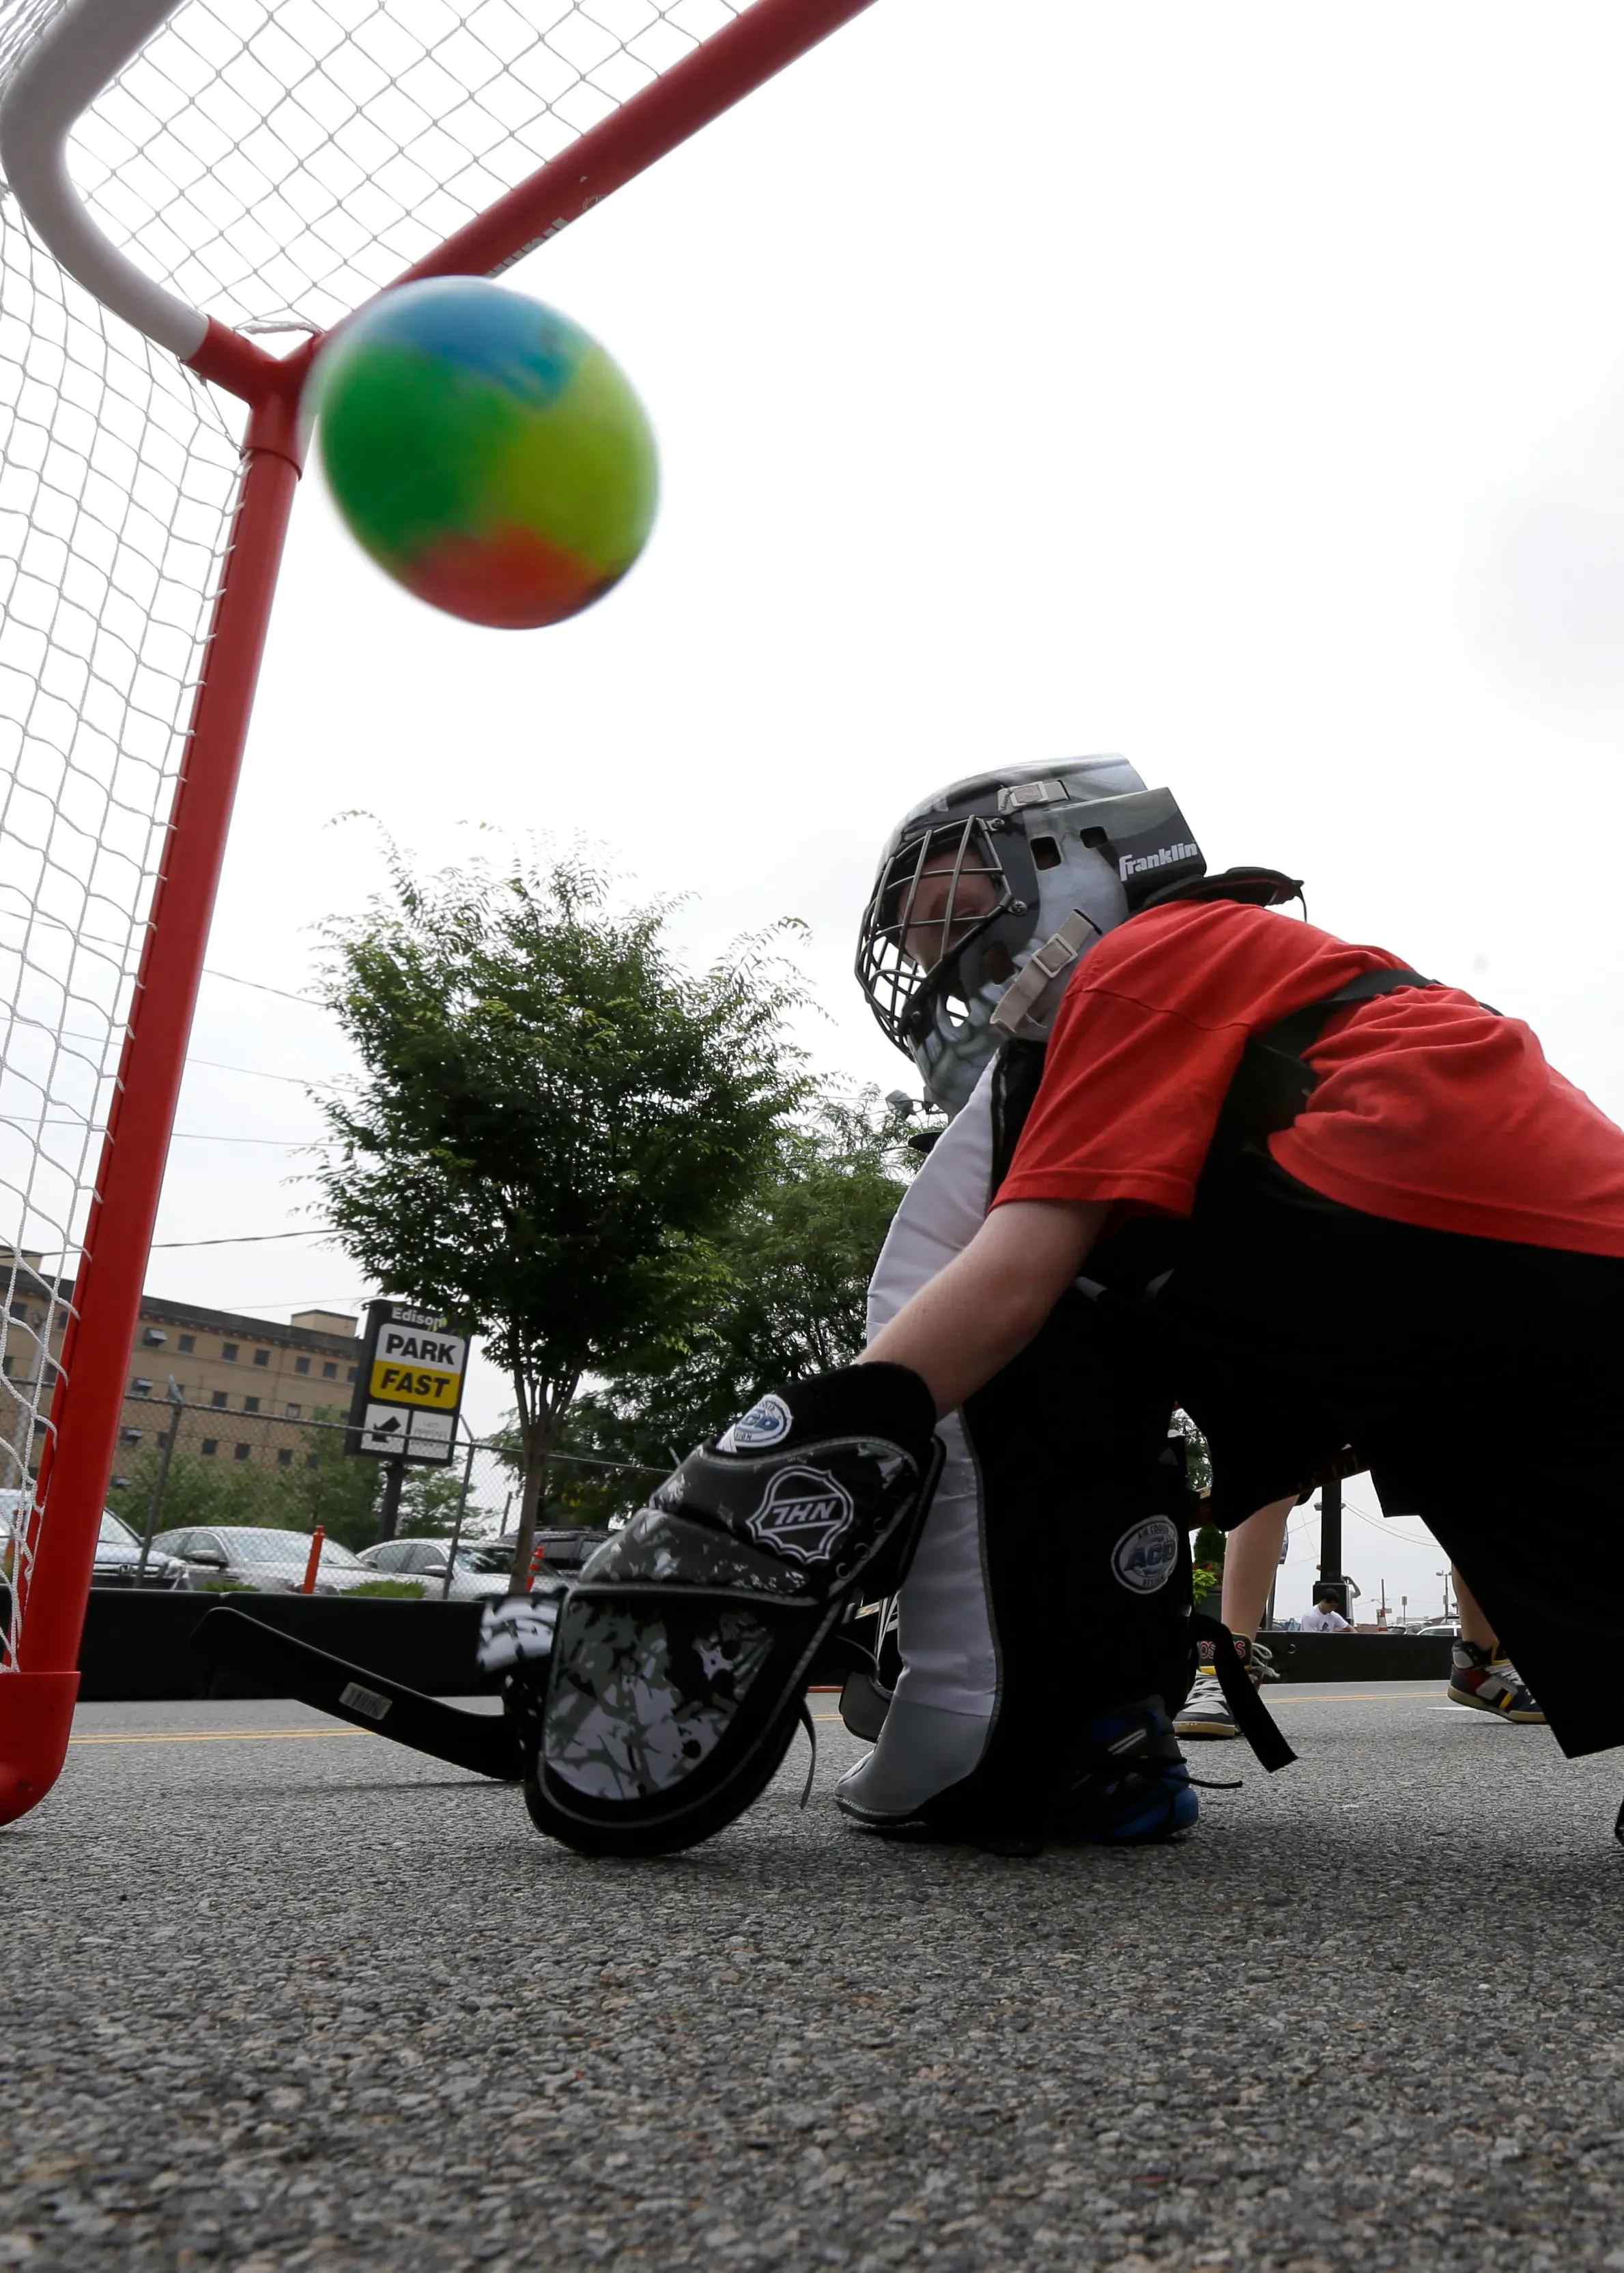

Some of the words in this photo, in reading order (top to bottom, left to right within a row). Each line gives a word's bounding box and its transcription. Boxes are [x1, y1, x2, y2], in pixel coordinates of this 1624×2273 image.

[1119, 843, 1198, 882] Franklin
[385, 1332, 457, 1365] PARK
[380, 1369, 451, 1399] FAST
[772, 1501, 836, 1526] NHL
